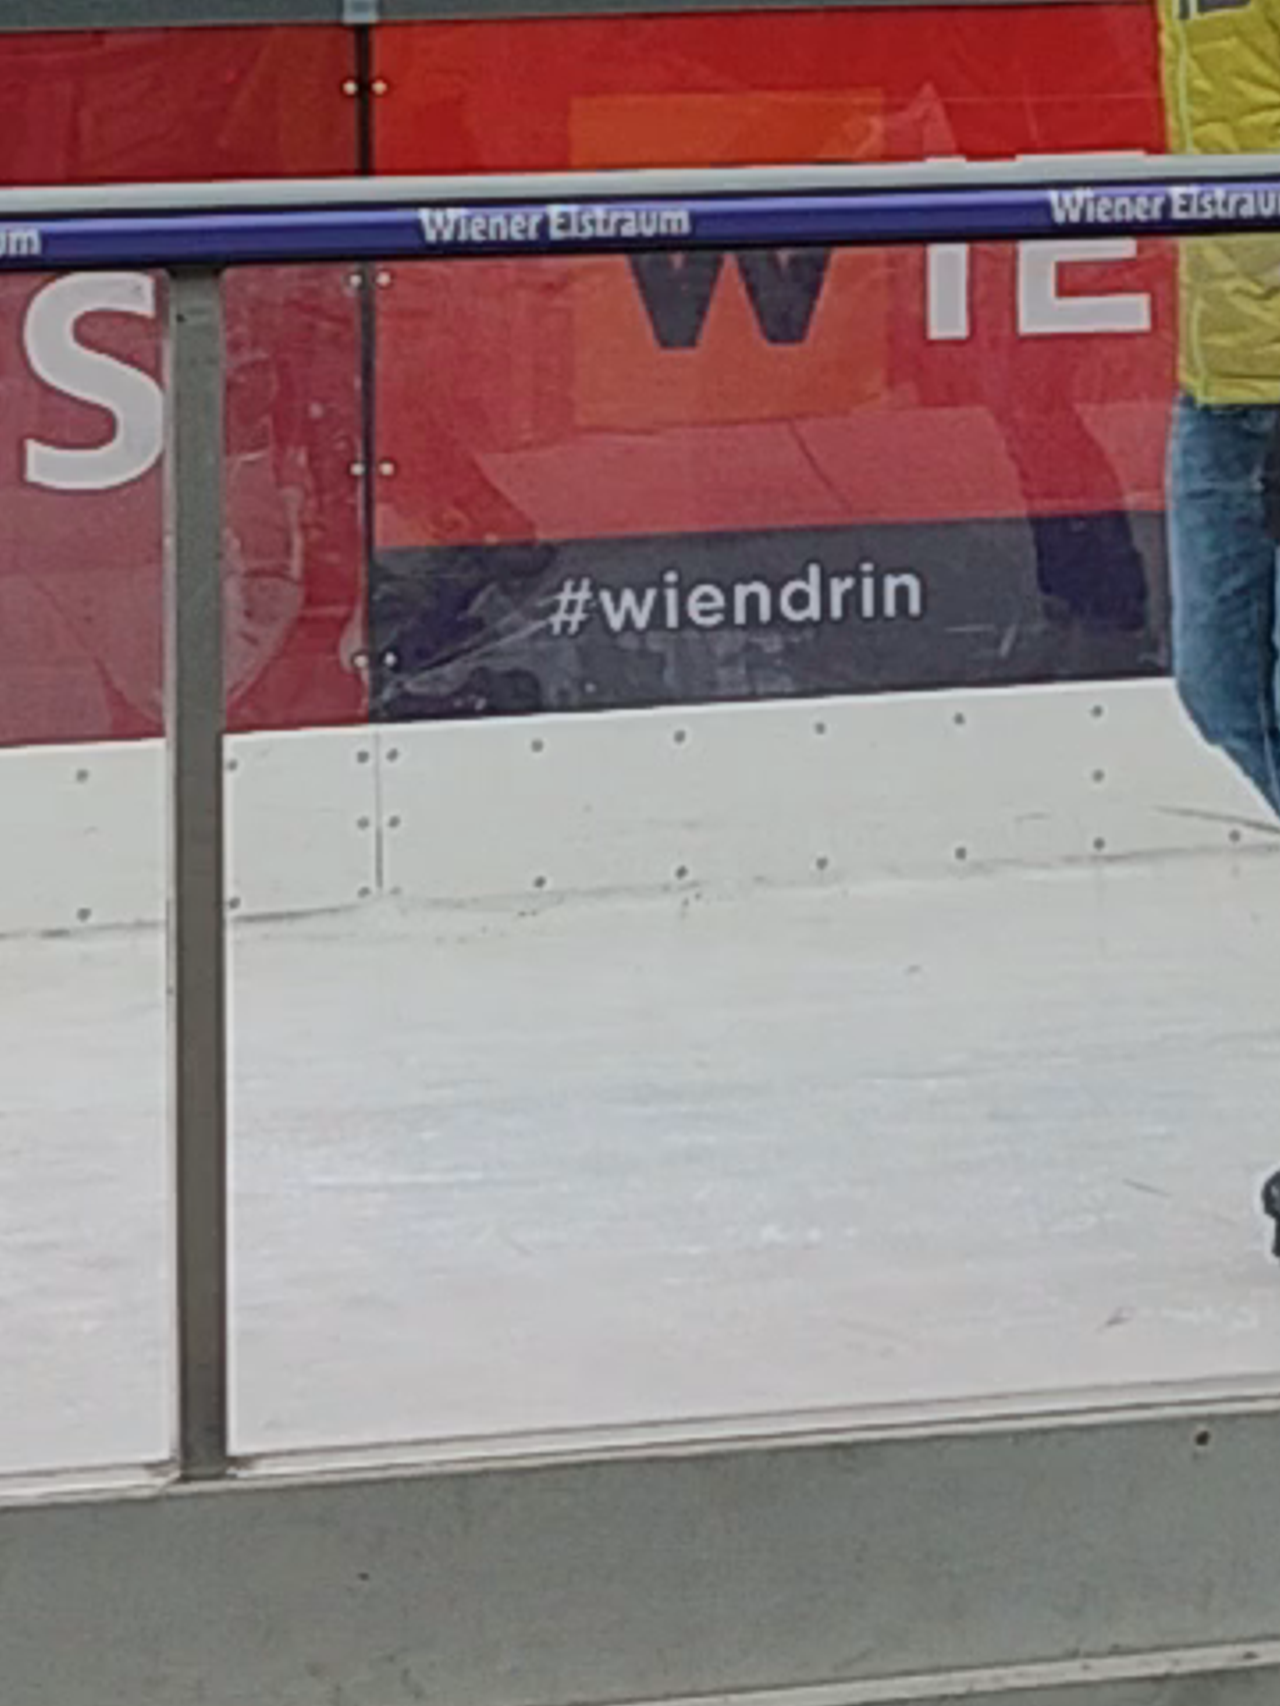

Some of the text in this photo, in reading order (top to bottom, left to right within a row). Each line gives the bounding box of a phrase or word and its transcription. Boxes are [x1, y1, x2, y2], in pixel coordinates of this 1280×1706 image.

[418, 204, 692, 244] Wiener Eistraum
[1048, 188, 1166, 225] Wiener
[548, 562, 923, 637] #wiendrin
